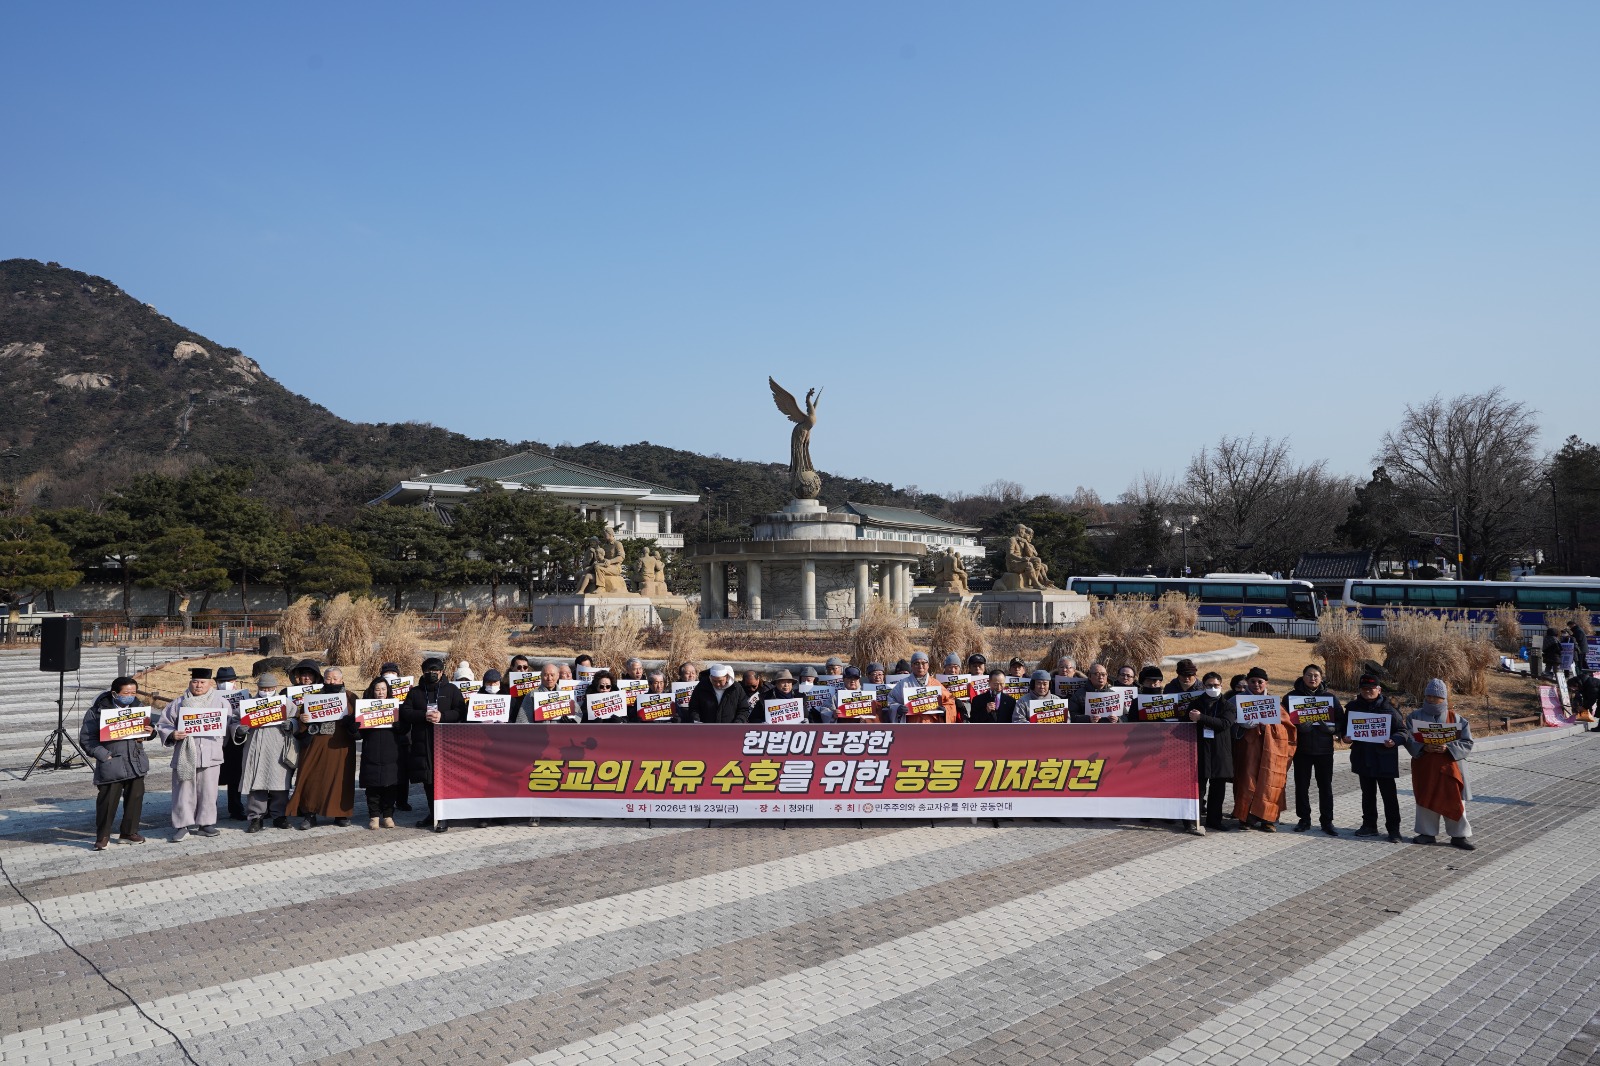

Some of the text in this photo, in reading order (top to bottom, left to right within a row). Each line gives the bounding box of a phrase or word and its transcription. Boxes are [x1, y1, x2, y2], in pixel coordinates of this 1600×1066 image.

[742, 730, 894, 755] 헌법이 보장한
[528, 759, 1105, 794] 종교의 자유 수호를 위한 공동 기자회견
[655, 804, 686, 812] 2026년
[689, 804, 701, 812] 1월
[704, 804, 738, 813] 23일(금)
[789, 804, 814, 812] 청와대
[875, 803, 916, 812] 민주주의와
[918, 803, 959, 812] 종교자유를
[961, 802, 977, 812] 위한
[980, 802, 1012, 812] 공동연대
